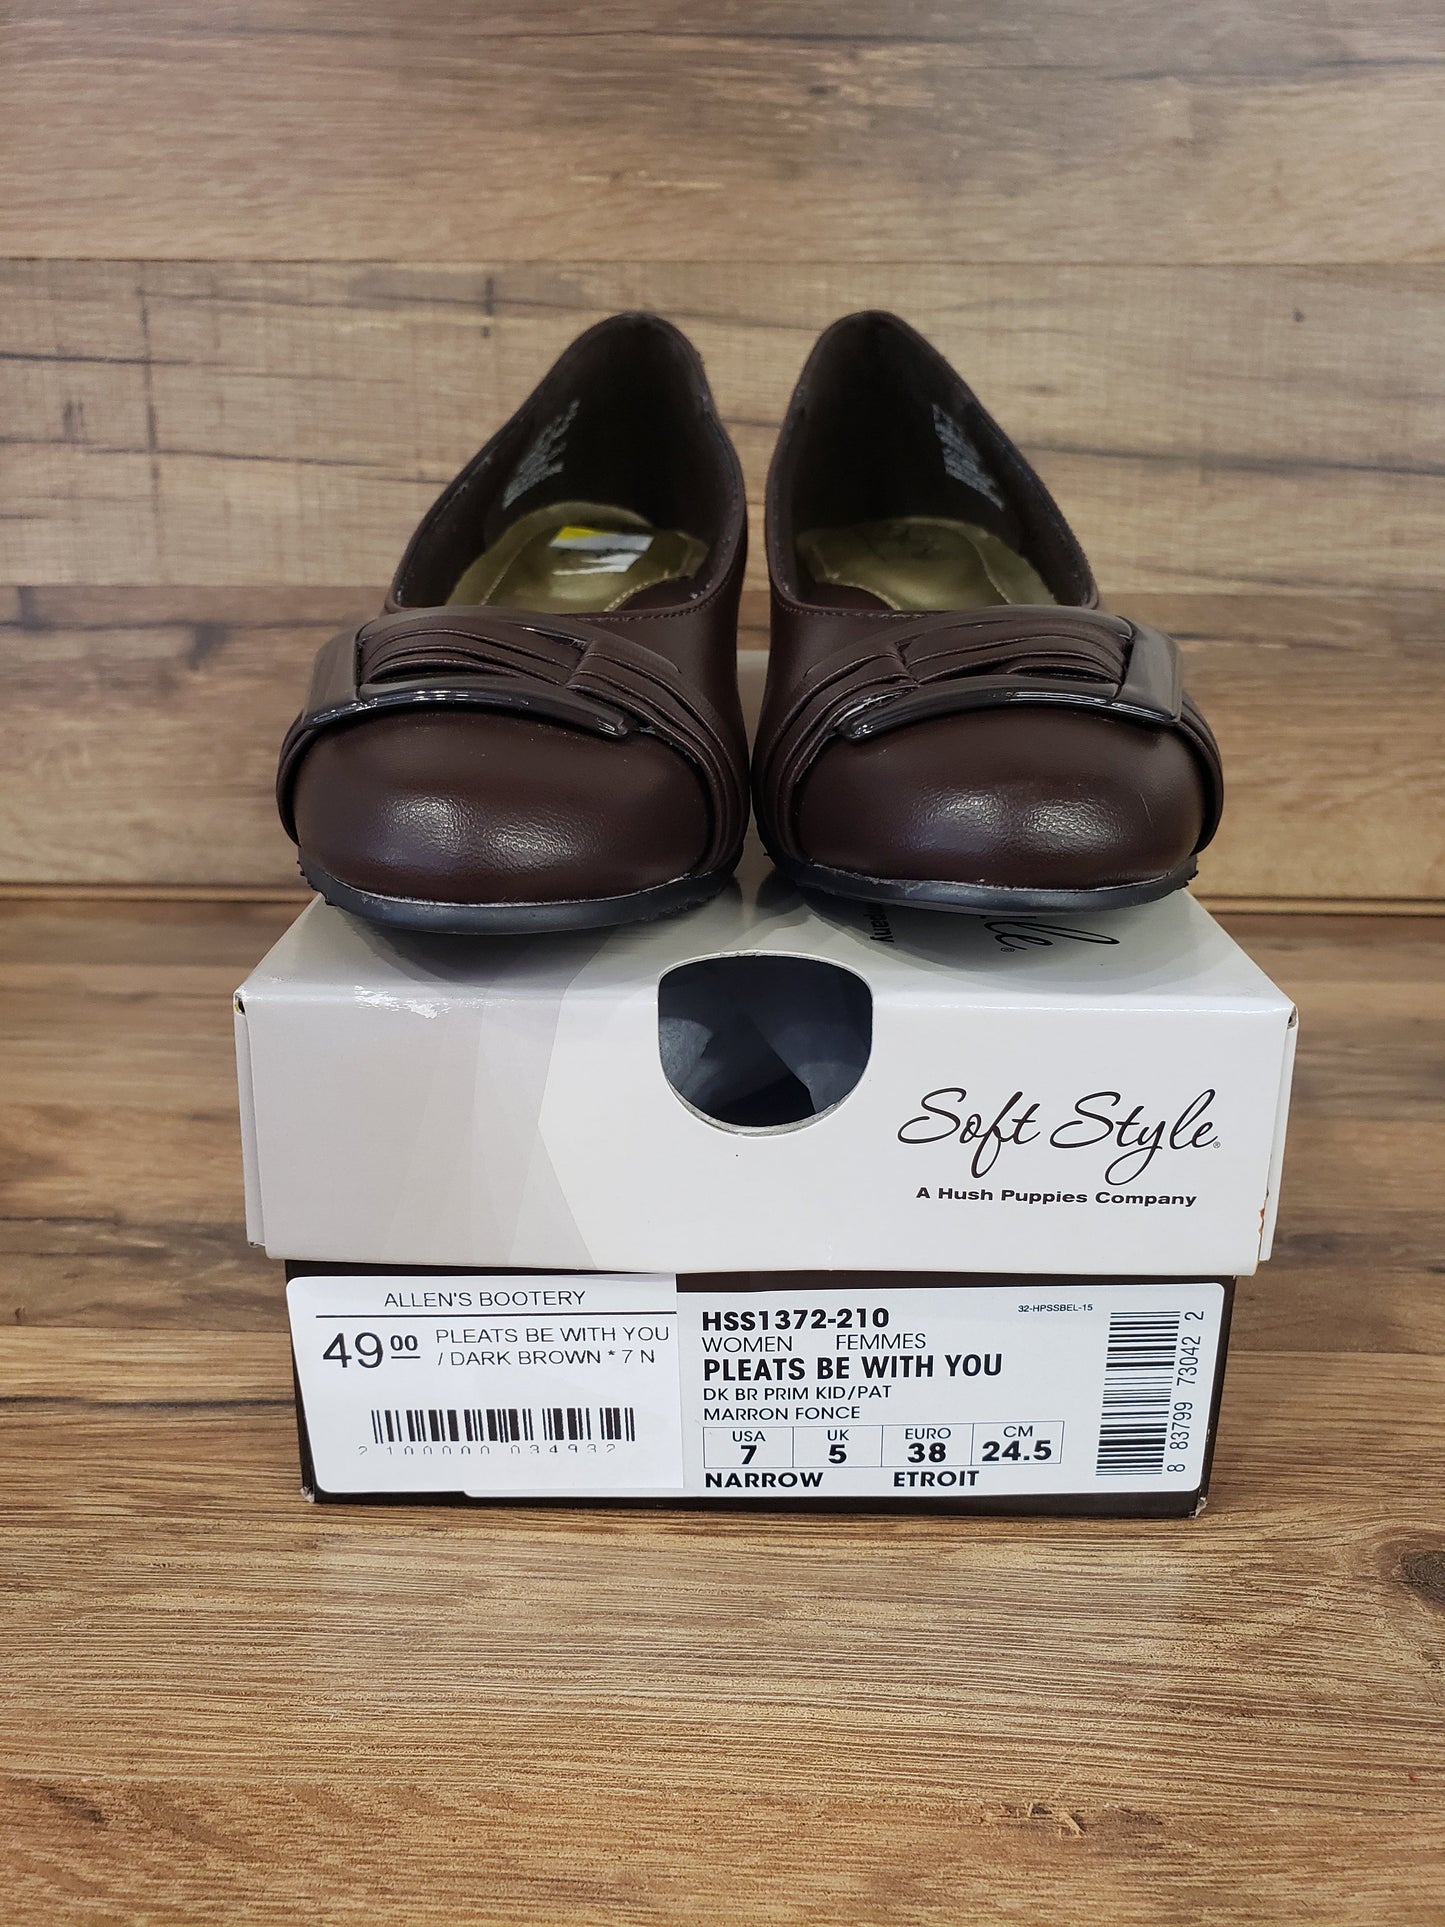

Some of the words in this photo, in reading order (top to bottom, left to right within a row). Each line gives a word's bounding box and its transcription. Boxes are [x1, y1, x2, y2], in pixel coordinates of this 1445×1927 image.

[898, 1088, 1040, 1178] Soft
[1050, 1089, 1218, 1185] Style
[916, 1187, 930, 1198] A
[939, 1188, 993, 1200] Hush
[1001, 1190, 1087, 1204] Puppies
[1096, 1192, 1196, 1207] Company
[385, 1293, 472, 1307] ALLEN'S
[480, 1291, 585, 1306] BOOTERY
[1018, 1304, 1092, 1312] 32-HPSSBEL-15
[703, 1308, 889, 1331] HSS1372-210
[436, 1329, 517, 1343] PLEATS
[526, 1328, 553, 1342] BE
[560, 1328, 615, 1341] WITH
[623, 1327, 668, 1341] YOU
[702, 1336, 792, 1352] WOMEN
[837, 1333, 926, 1350] FEMMES
[323, 1333, 383, 1368] 49
[391, 1335, 418, 1351] 00
[451, 1351, 510, 1365] DARK
[519, 1350, 600, 1364] BROWN
[622, 1350, 632, 1363] 7
[641, 1350, 654, 1363] N
[704, 1358, 805, 1381] PLEATS
[818, 1357, 849, 1379] BE
[861, 1355, 933, 1378] WITH
[945, 1354, 1002, 1376] YOU
[1177, 1336, 1200, 1386] 73042
[704, 1388, 728, 1400] DK
[736, 1388, 757, 1400] BR
[765, 1387, 808, 1400] PRIM
[817, 1385, 891, 1400] KID/PAT
[704, 1408, 788, 1420] MARRON
[796, 1406, 859, 1419] FONCE
[733, 1431, 766, 1442] USA
[828, 1430, 849, 1441] UK
[905, 1428, 951, 1439] EURO
[1004, 1426, 1033, 1437] CM
[1169, 1402, 1192, 1449] 83799
[741, 1445, 757, 1464] 7
[829, 1444, 846, 1464] 5
[908, 1443, 946, 1463] 38
[982, 1440, 1051, 1461] 24.5
[706, 1472, 823, 1487] NARROW
[894, 1471, 979, 1487] ETROIT
